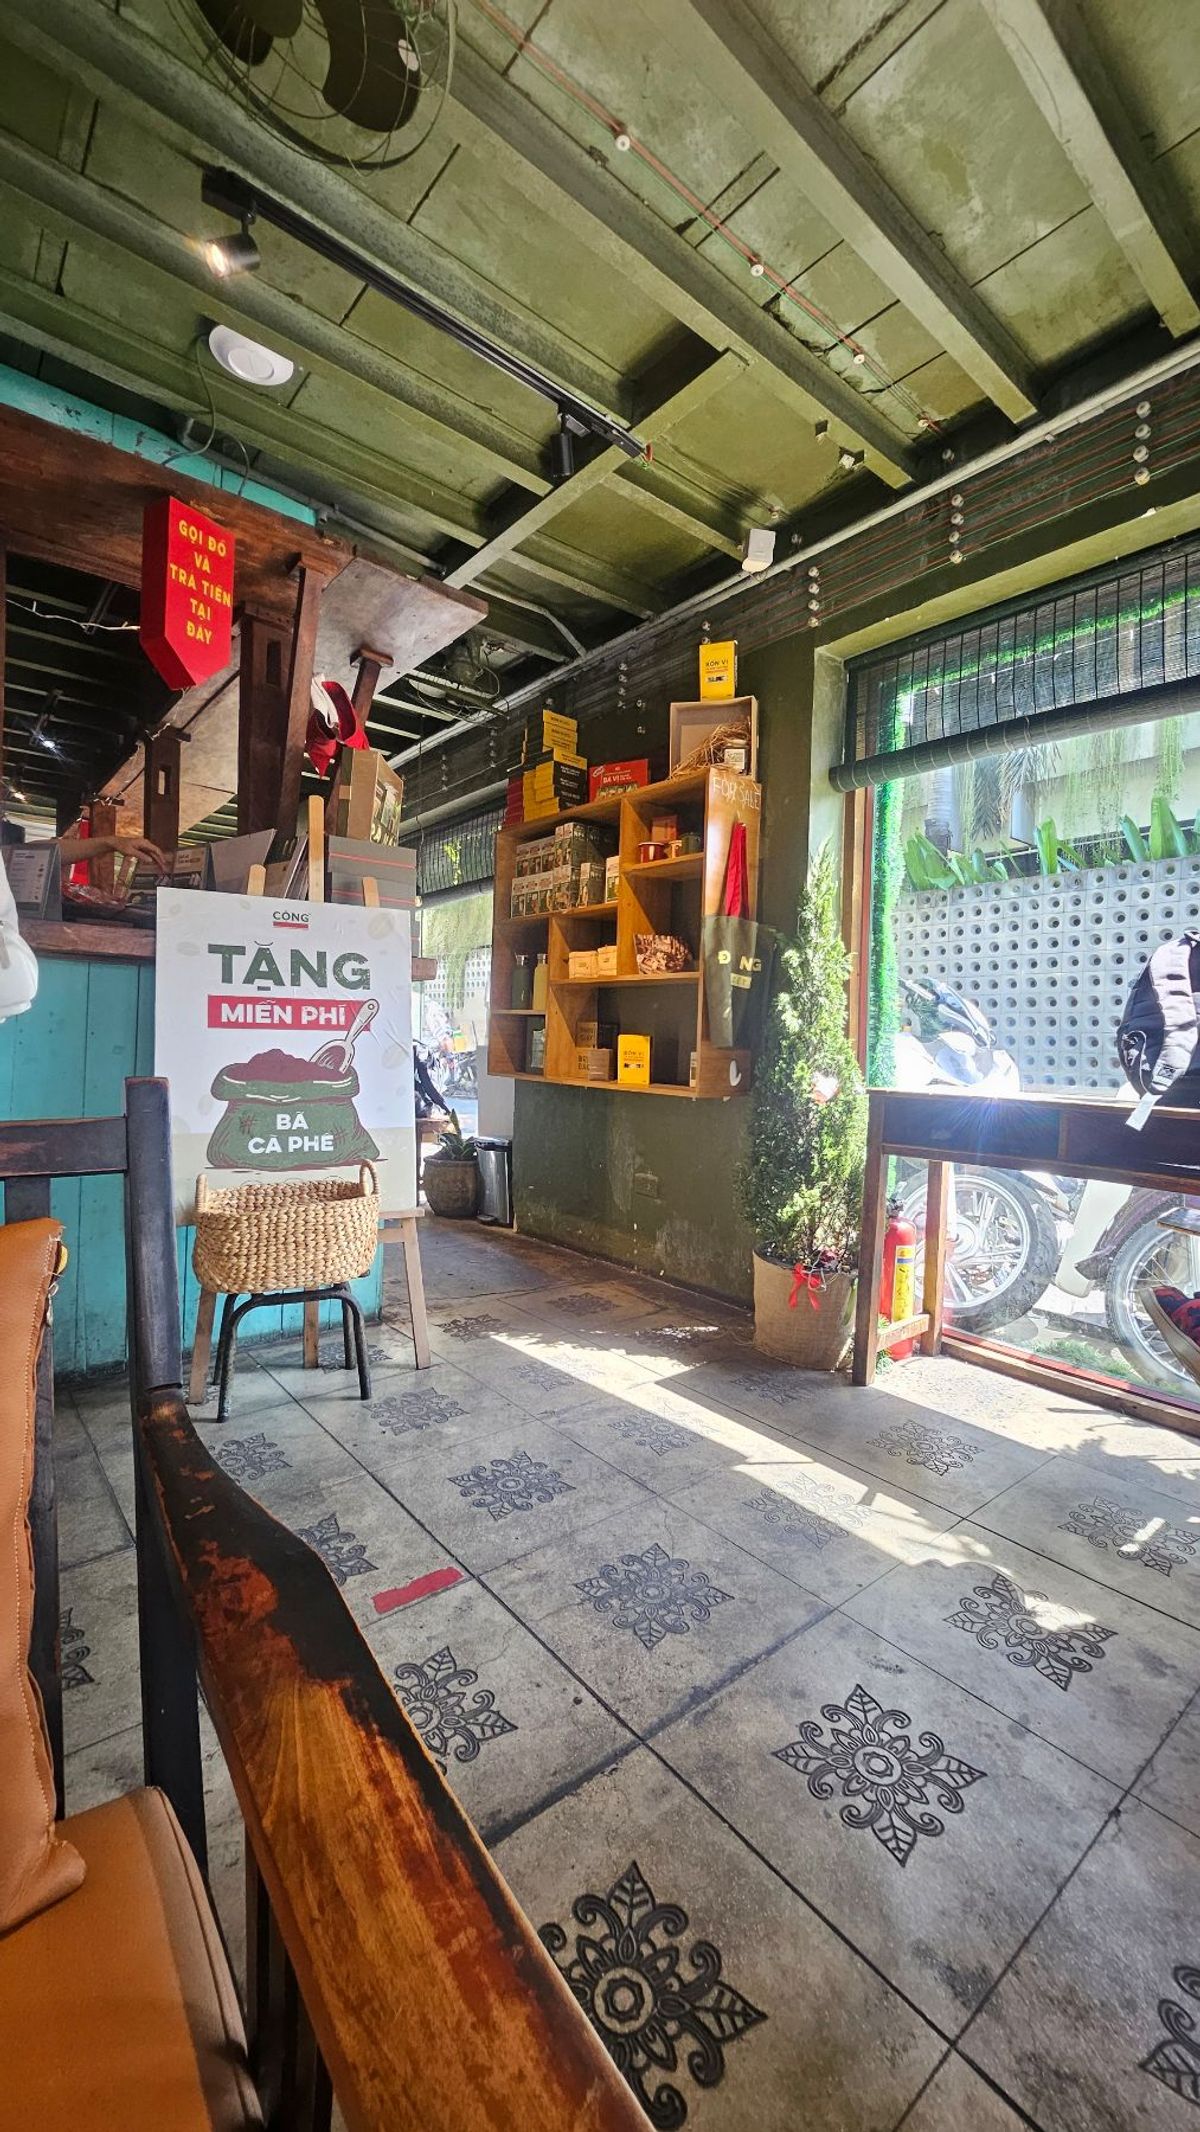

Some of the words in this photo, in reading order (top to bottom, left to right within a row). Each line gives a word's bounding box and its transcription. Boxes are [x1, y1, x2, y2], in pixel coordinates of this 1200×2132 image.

[711, 777, 737, 801] FOR
[738, 780, 761, 810] SALE
[207, 940, 371, 991] TẶNG
[221, 1000, 292, 1025] MIỄN
[301, 1004, 347, 1026] PHÍ
[276, 1111, 309, 1130] BÃ
[288, 1133, 334, 1153] PHÊ
